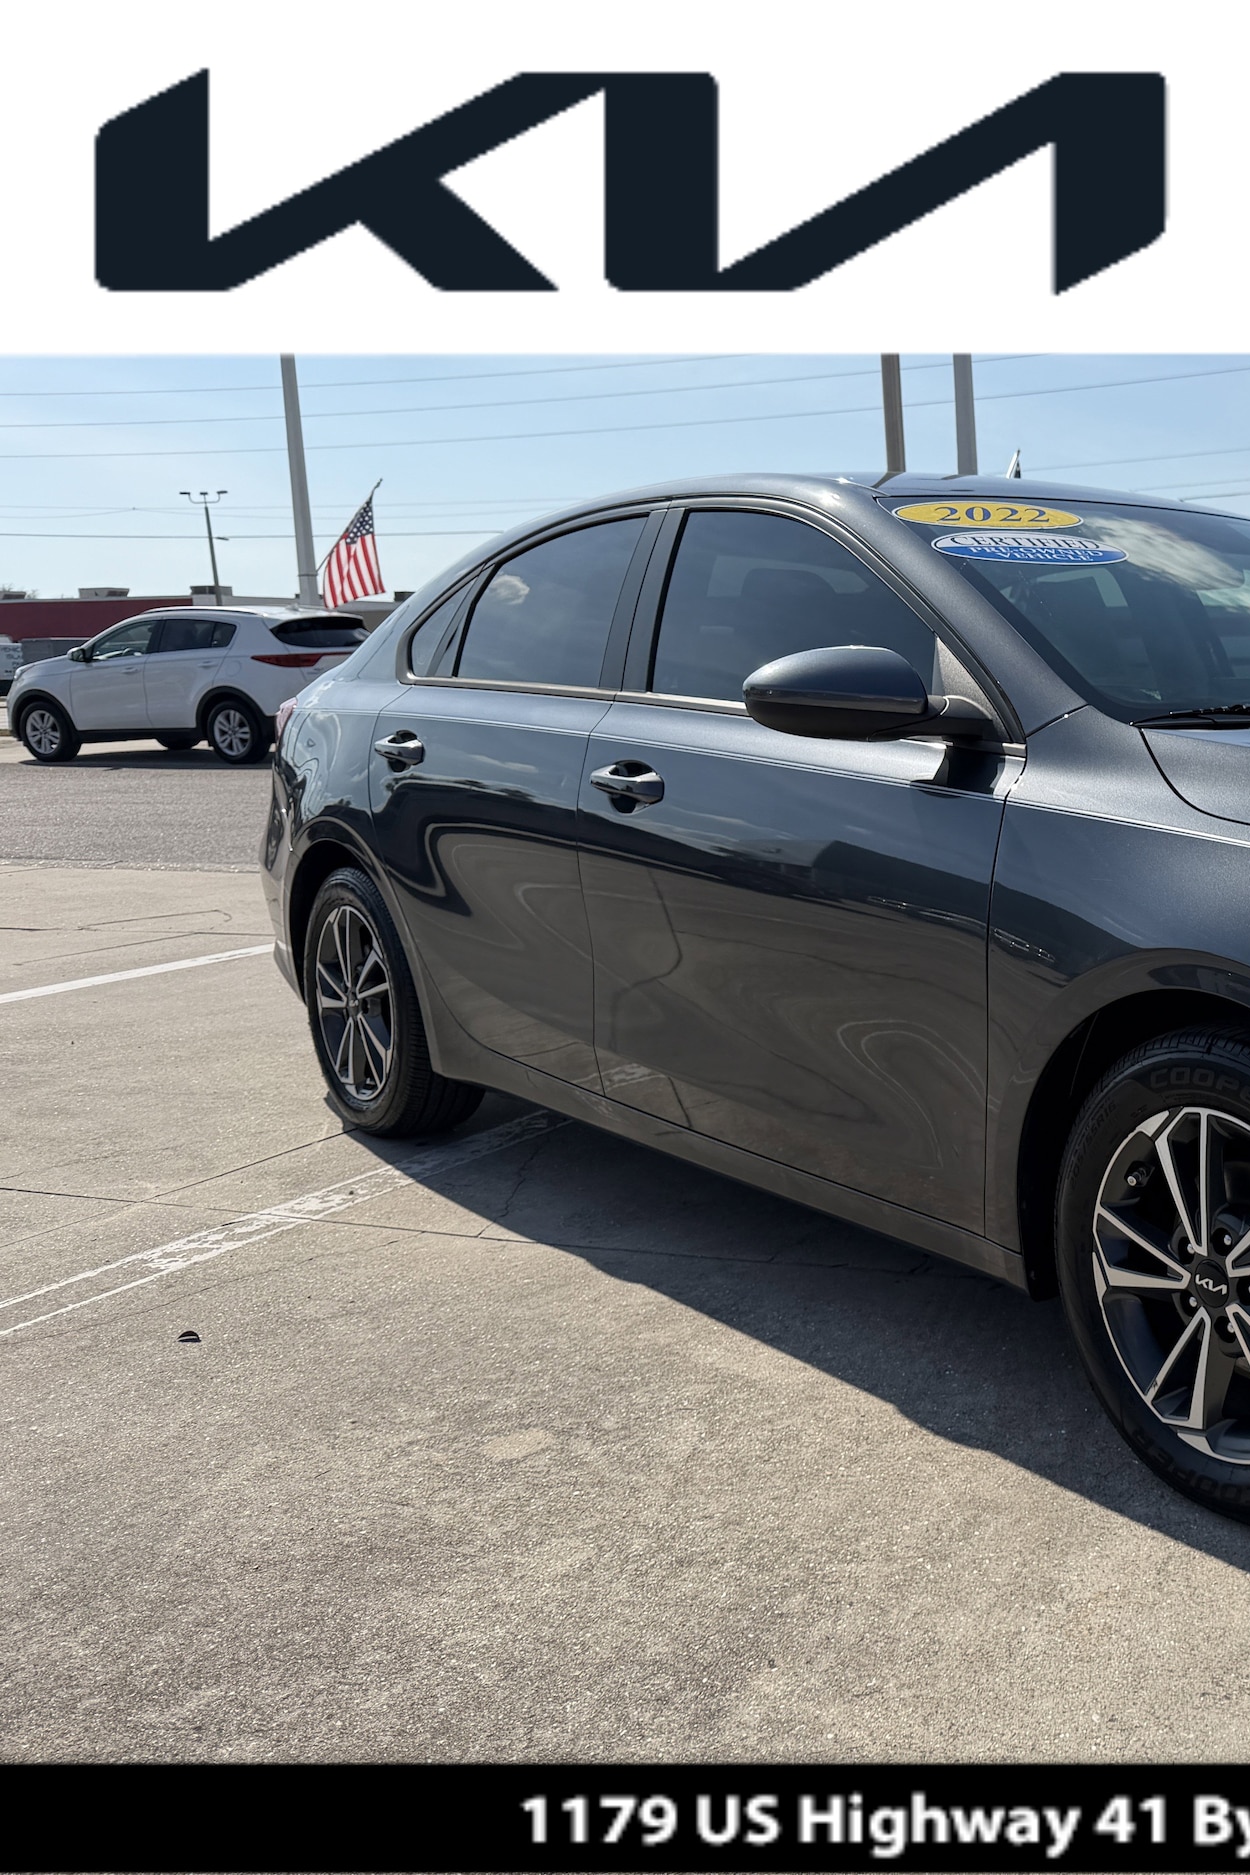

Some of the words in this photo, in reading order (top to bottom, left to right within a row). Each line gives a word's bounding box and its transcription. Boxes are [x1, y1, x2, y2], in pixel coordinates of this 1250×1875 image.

[936, 505, 1050, 523] 2022
[950, 536, 1101, 549] CERTIFIED
[968, 545, 1104, 558] PRE-OWNED
[996, 551, 1094, 562] VEHICLE
